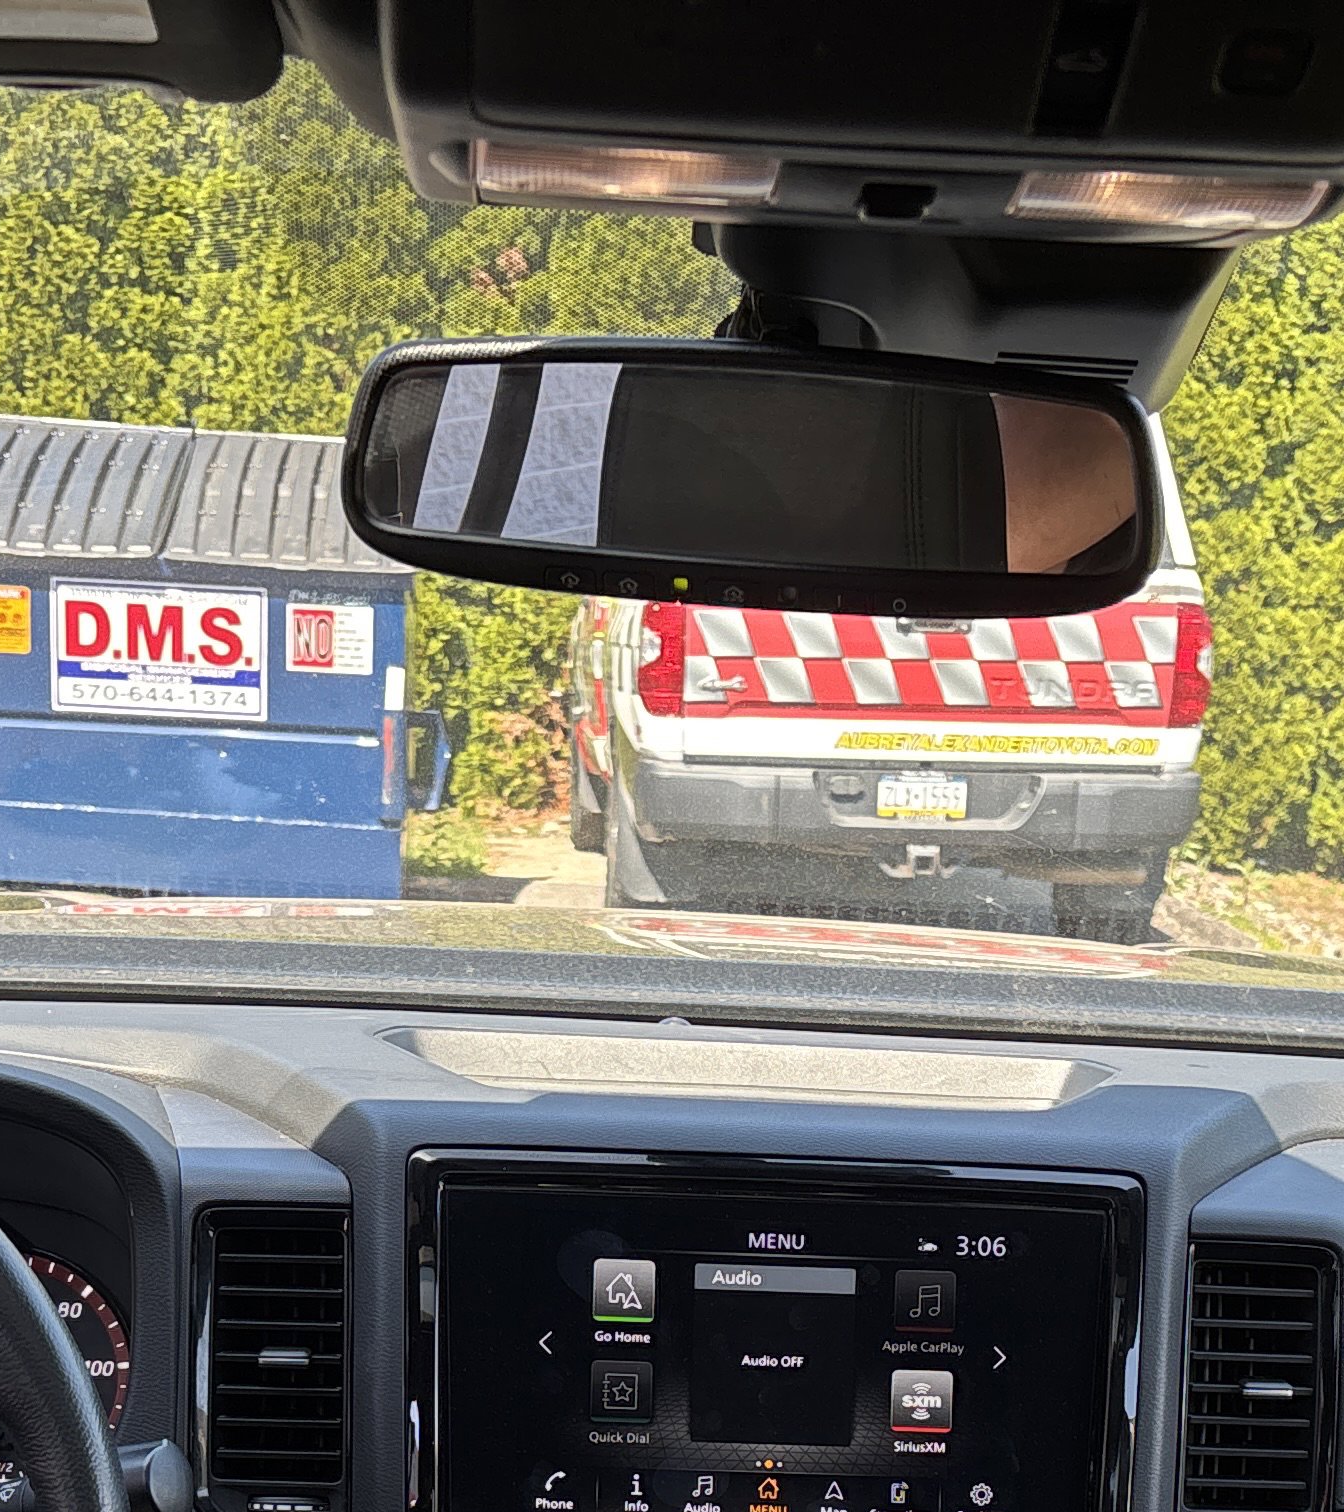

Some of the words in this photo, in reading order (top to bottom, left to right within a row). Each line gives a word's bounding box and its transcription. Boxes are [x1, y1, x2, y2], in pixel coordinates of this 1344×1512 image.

[64, 599, 253, 666] D.M.S.
[294, 613, 333, 664] NO
[72, 683, 248, 707] 570-644-1374
[747, 1232, 805, 1250] MENU
[955, 1236, 1007, 1257] 3:06
[712, 1270, 763, 1286] Audio
[58, 1302, 83, 1319] 80
[594, 1330, 613, 1342] Go
[614, 1331, 651, 1343] Home
[882, 1340, 918, 1354] Apple
[920, 1341, 964, 1356] CarPlay
[741, 1355, 778, 1368] Audio
[780, 1355, 805, 1368] OFF
[901, 1395, 942, 1408] sxm
[589, 1431, 623, 1444] Quick
[626, 1432, 650, 1444] Dial
[893, 1440, 946, 1453] SiriusXM
[535, 1497, 574, 1510] Phone
[624, 1500, 649, 1512] Info
